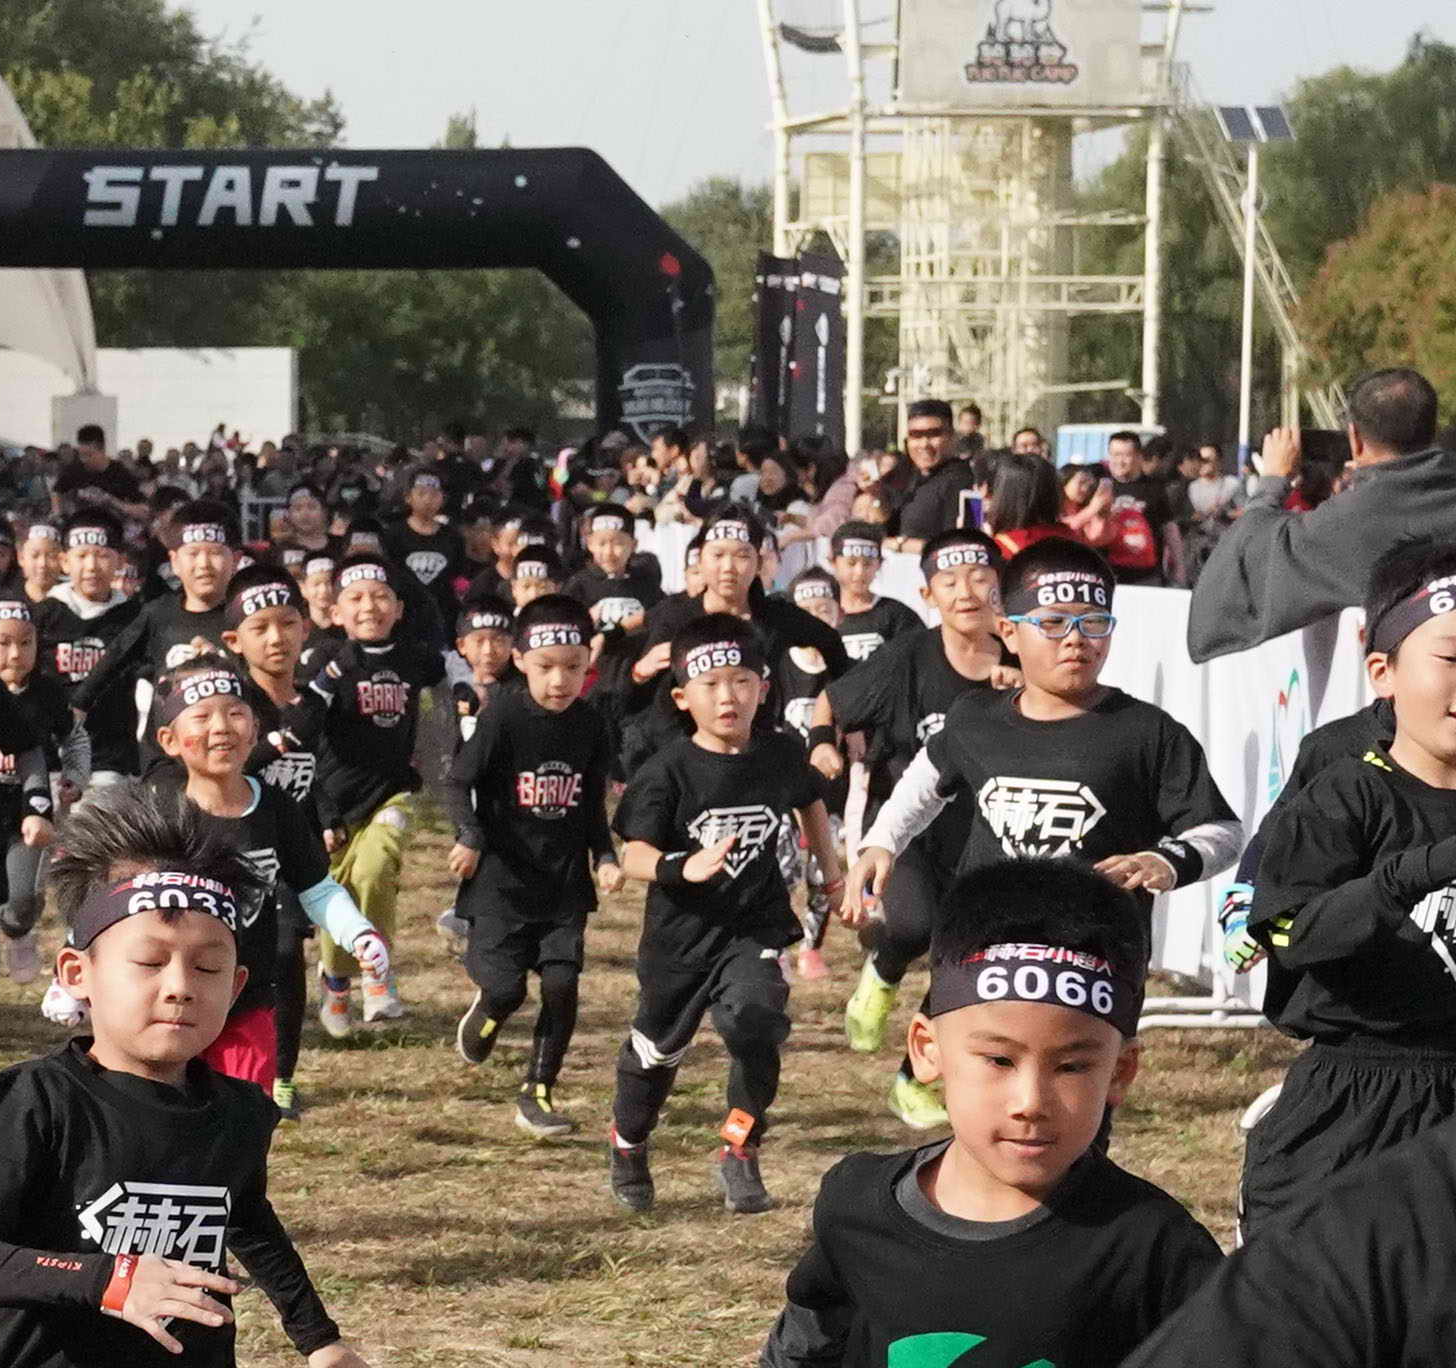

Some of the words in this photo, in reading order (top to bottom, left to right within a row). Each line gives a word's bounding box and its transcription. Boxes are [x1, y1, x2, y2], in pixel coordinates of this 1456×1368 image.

[84, 164, 379, 227] START
[242, 591, 291, 616] 6117
[1037, 583, 1107, 606] 6016
[687, 649, 742, 680] 6059
[183, 679, 243, 706] 6091
[987, 786, 1087, 841] 赫石
[976, 964, 1114, 1015] 6066
[100, 1195, 228, 1268] 赫石
